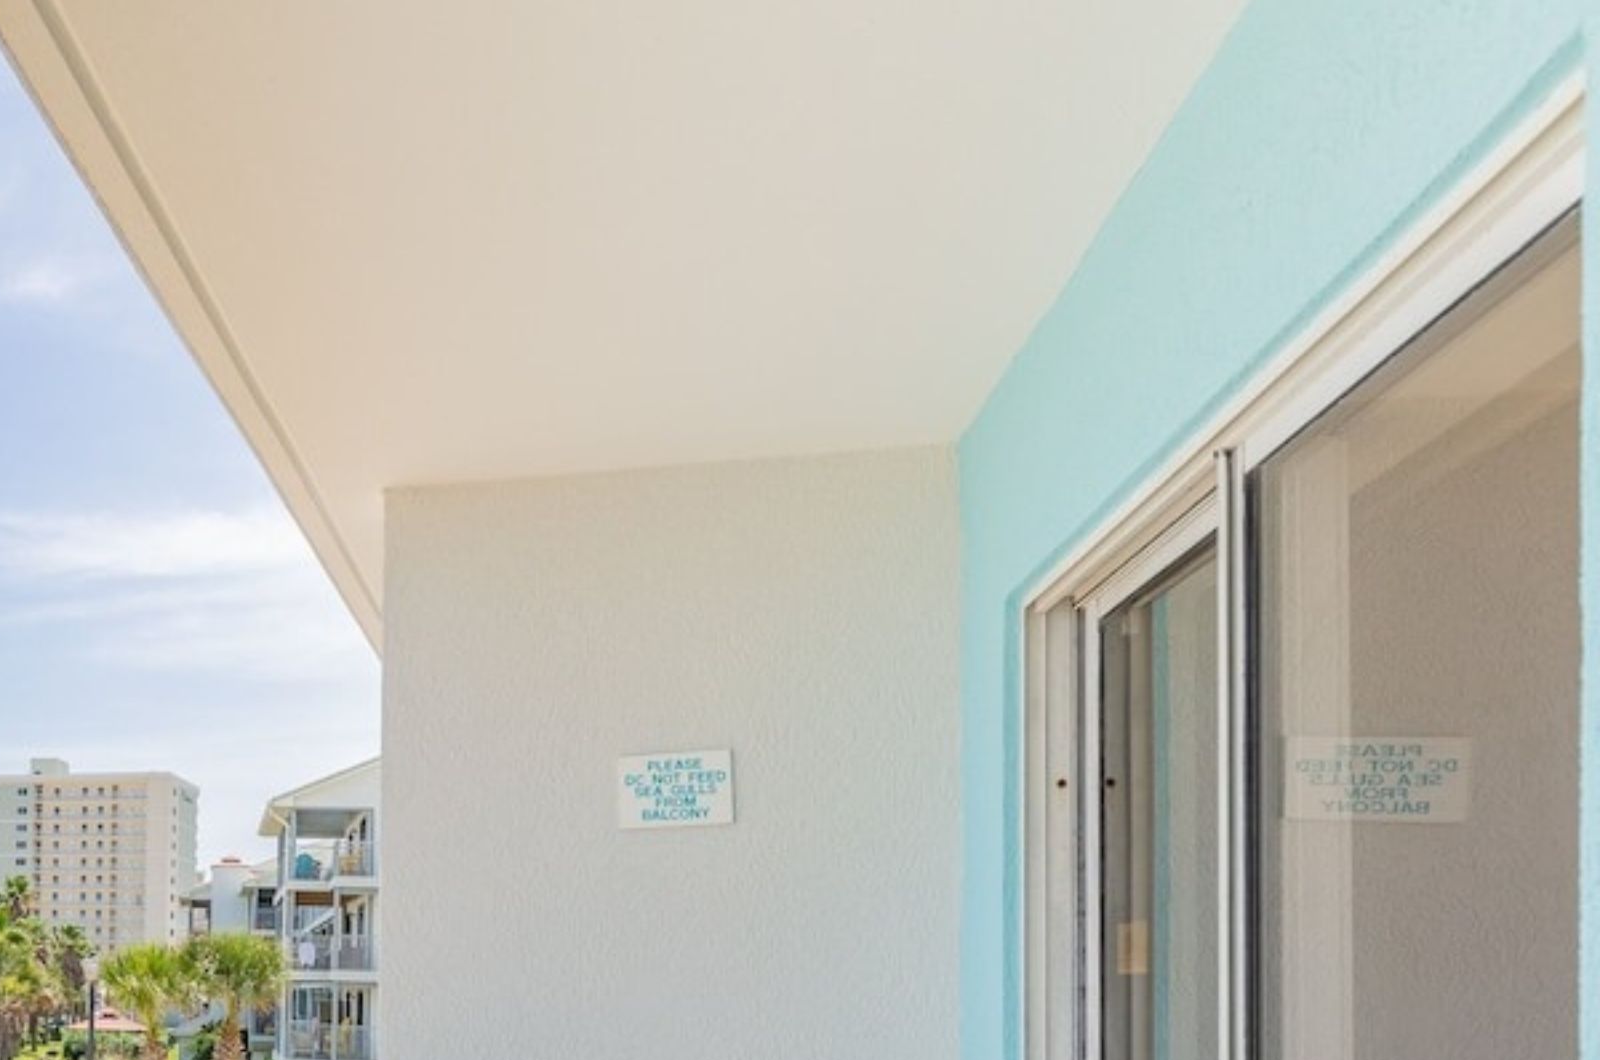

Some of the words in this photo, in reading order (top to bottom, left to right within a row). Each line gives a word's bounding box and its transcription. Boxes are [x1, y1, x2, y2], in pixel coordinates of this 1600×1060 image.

[647, 758, 702, 771] PLEASE
[652, 771, 681, 785] NOT
[687, 769, 726, 783] FEED
[634, 785, 662, 798] SEA
[671, 782, 717, 795] GULLS
[656, 795, 697, 807] FROM
[642, 806, 710, 821] BALCONY
